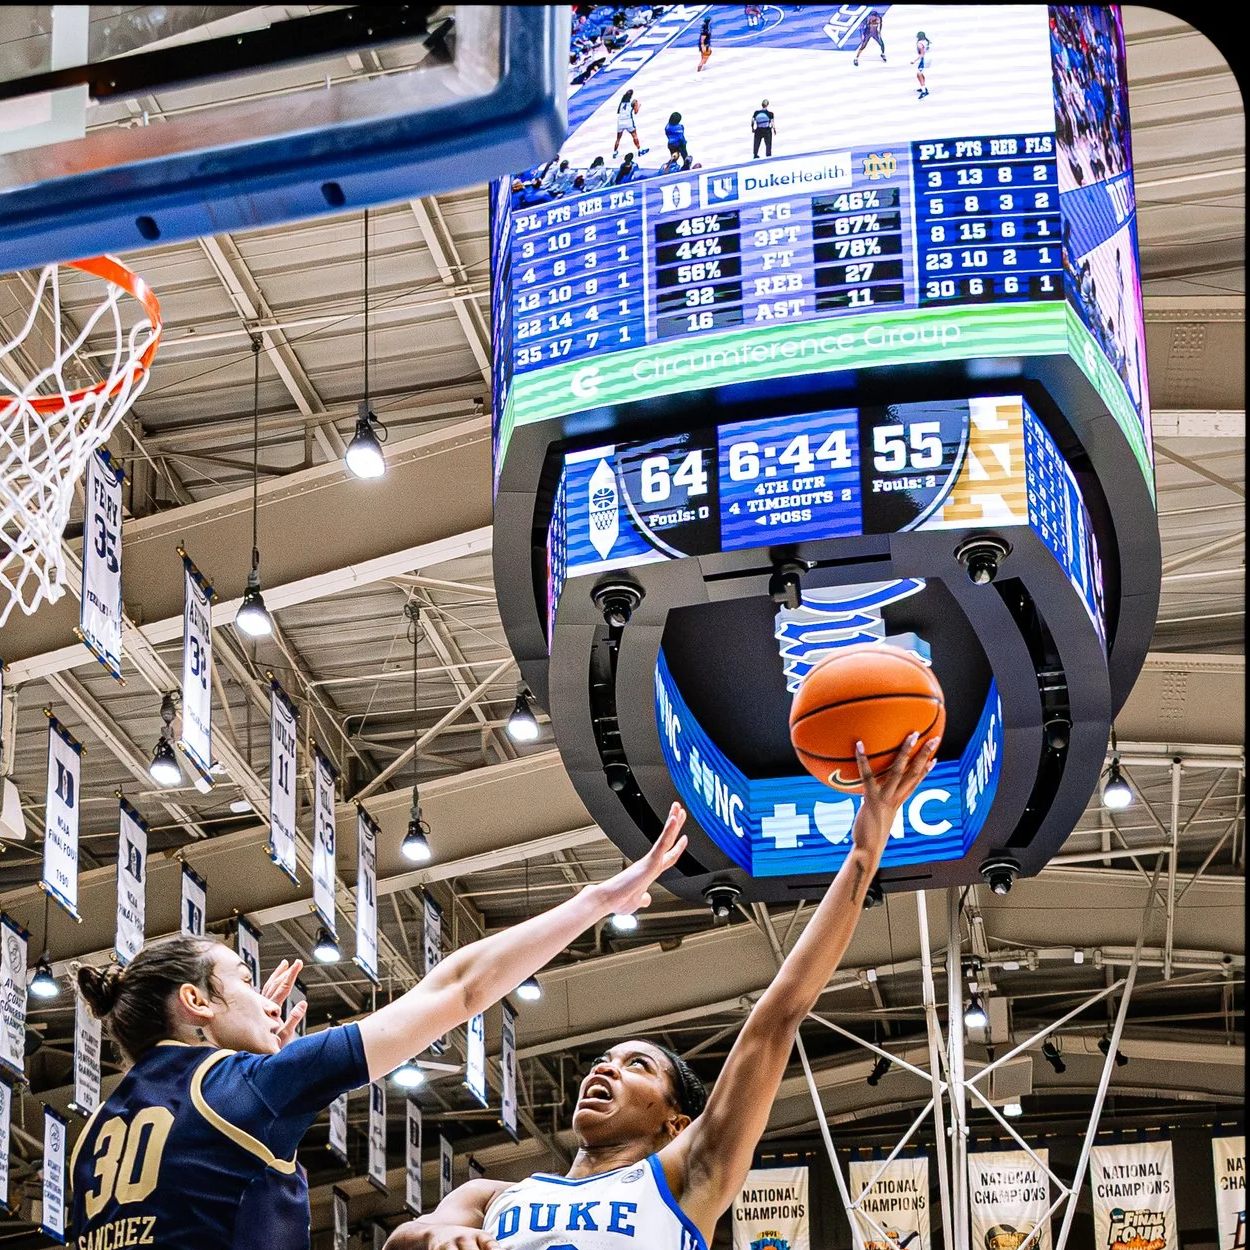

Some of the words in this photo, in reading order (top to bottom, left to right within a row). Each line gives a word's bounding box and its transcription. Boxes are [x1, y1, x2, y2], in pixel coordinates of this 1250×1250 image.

[919, 144, 950, 160] PL
[955, 141, 982, 157] PTS
[990, 139, 1017, 155] REB
[1025, 137, 1052, 153] FLS
[745, 165, 844, 191] DukeHealth
[928, 171, 942, 187] 3
[957, 168, 983, 185] 13
[998, 167, 1012, 183] 8
[1033, 165, 1047, 181] 2
[515, 216, 541, 233] PL
[547, 205, 571, 225] PTS
[578, 198, 602, 217] REB
[610, 190, 634, 209] FLS
[676, 215, 720, 237] 45%
[761, 203, 791, 222] FG
[834, 191, 880, 212] 46%
[929, 199, 943, 214] 5
[965, 196, 979, 212] 8
[999, 194, 1014, 210] 3
[1034, 192, 1049, 209] 2
[522, 242, 535, 258] 3
[548, 232, 571, 252] 10
[584, 225, 597, 242] 2
[617, 219, 629, 235] 1
[676, 238, 722, 260] 44%
[754, 226, 801, 248] 3PT
[834, 214, 880, 235] 67%
[930, 226, 945, 242] 8
[960, 223, 986, 240] 15
[1001, 222, 1016, 237] 6
[1037, 220, 1050, 236] 1
[522, 268, 536, 284] 4
[553, 260, 566, 276] 8
[585, 252, 597, 269] 3
[617, 245, 629, 261] 1
[677, 261, 721, 284] 56%
[762, 251, 794, 270] FT
[835, 237, 881, 259] 78%
[926, 253, 953, 271] 23
[961, 250, 988, 267] 10
[1003, 249, 1017, 265] 2
[1038, 248, 1052, 263] 1
[518, 293, 540, 312] 12
[548, 285, 572, 305] 10
[618, 272, 630, 289] 1
[686, 287, 715, 306] 32
[754, 274, 803, 296] REB
[845, 263, 874, 283] 27
[926, 280, 955, 298] 30
[969, 278, 984, 295] 6
[1004, 277, 1019, 293] 6
[1040, 275, 1054, 291] 1
[518, 319, 541, 339] 22
[549, 312, 572, 331] 14
[585, 305, 599, 321] 4
[618, 299, 631, 316] 1
[687, 312, 714, 331] 16
[755, 299, 806, 321] AST
[847, 288, 874, 308] 11
[518, 346, 542, 366] 35
[549, 339, 573, 358] 17
[586, 332, 599, 349] 7
[619, 326, 631, 342] 1
[632, 330, 854, 382] Circumference
[863, 322, 961, 348] Group
[728, 429, 851, 482] 6:44
[872, 421, 944, 472] 55
[641, 450, 708, 503] 64
[754, 479, 789, 495] 4TH
[791, 476, 827, 492] QTR
[872, 477, 921, 493] Fouls:
[924, 475, 936, 488] 2
[728, 502, 740, 516] 4
[747, 491, 833, 513] TIMEOUTS
[841, 488, 852, 501] 2
[649, 508, 697, 527] Fouls:
[769, 508, 812, 525] POSS
[85, 1106, 175, 1220] 30
[1103, 1162, 1162, 1180] NATIONAL
[980, 1171, 1038, 1186] NATIONAL
[1097, 1180, 1171, 1199] CHAMPIONS
[743, 1187, 798, 1203] NATIONAL
[974, 1187, 1046, 1204] CHAMPIONS
[495, 1201, 637, 1241] DUKE
[736, 1204, 805, 1221] CHAMPIONS
[1124, 1210, 1165, 1226] FINAL
[1110, 1222, 1165, 1244] FOUR
